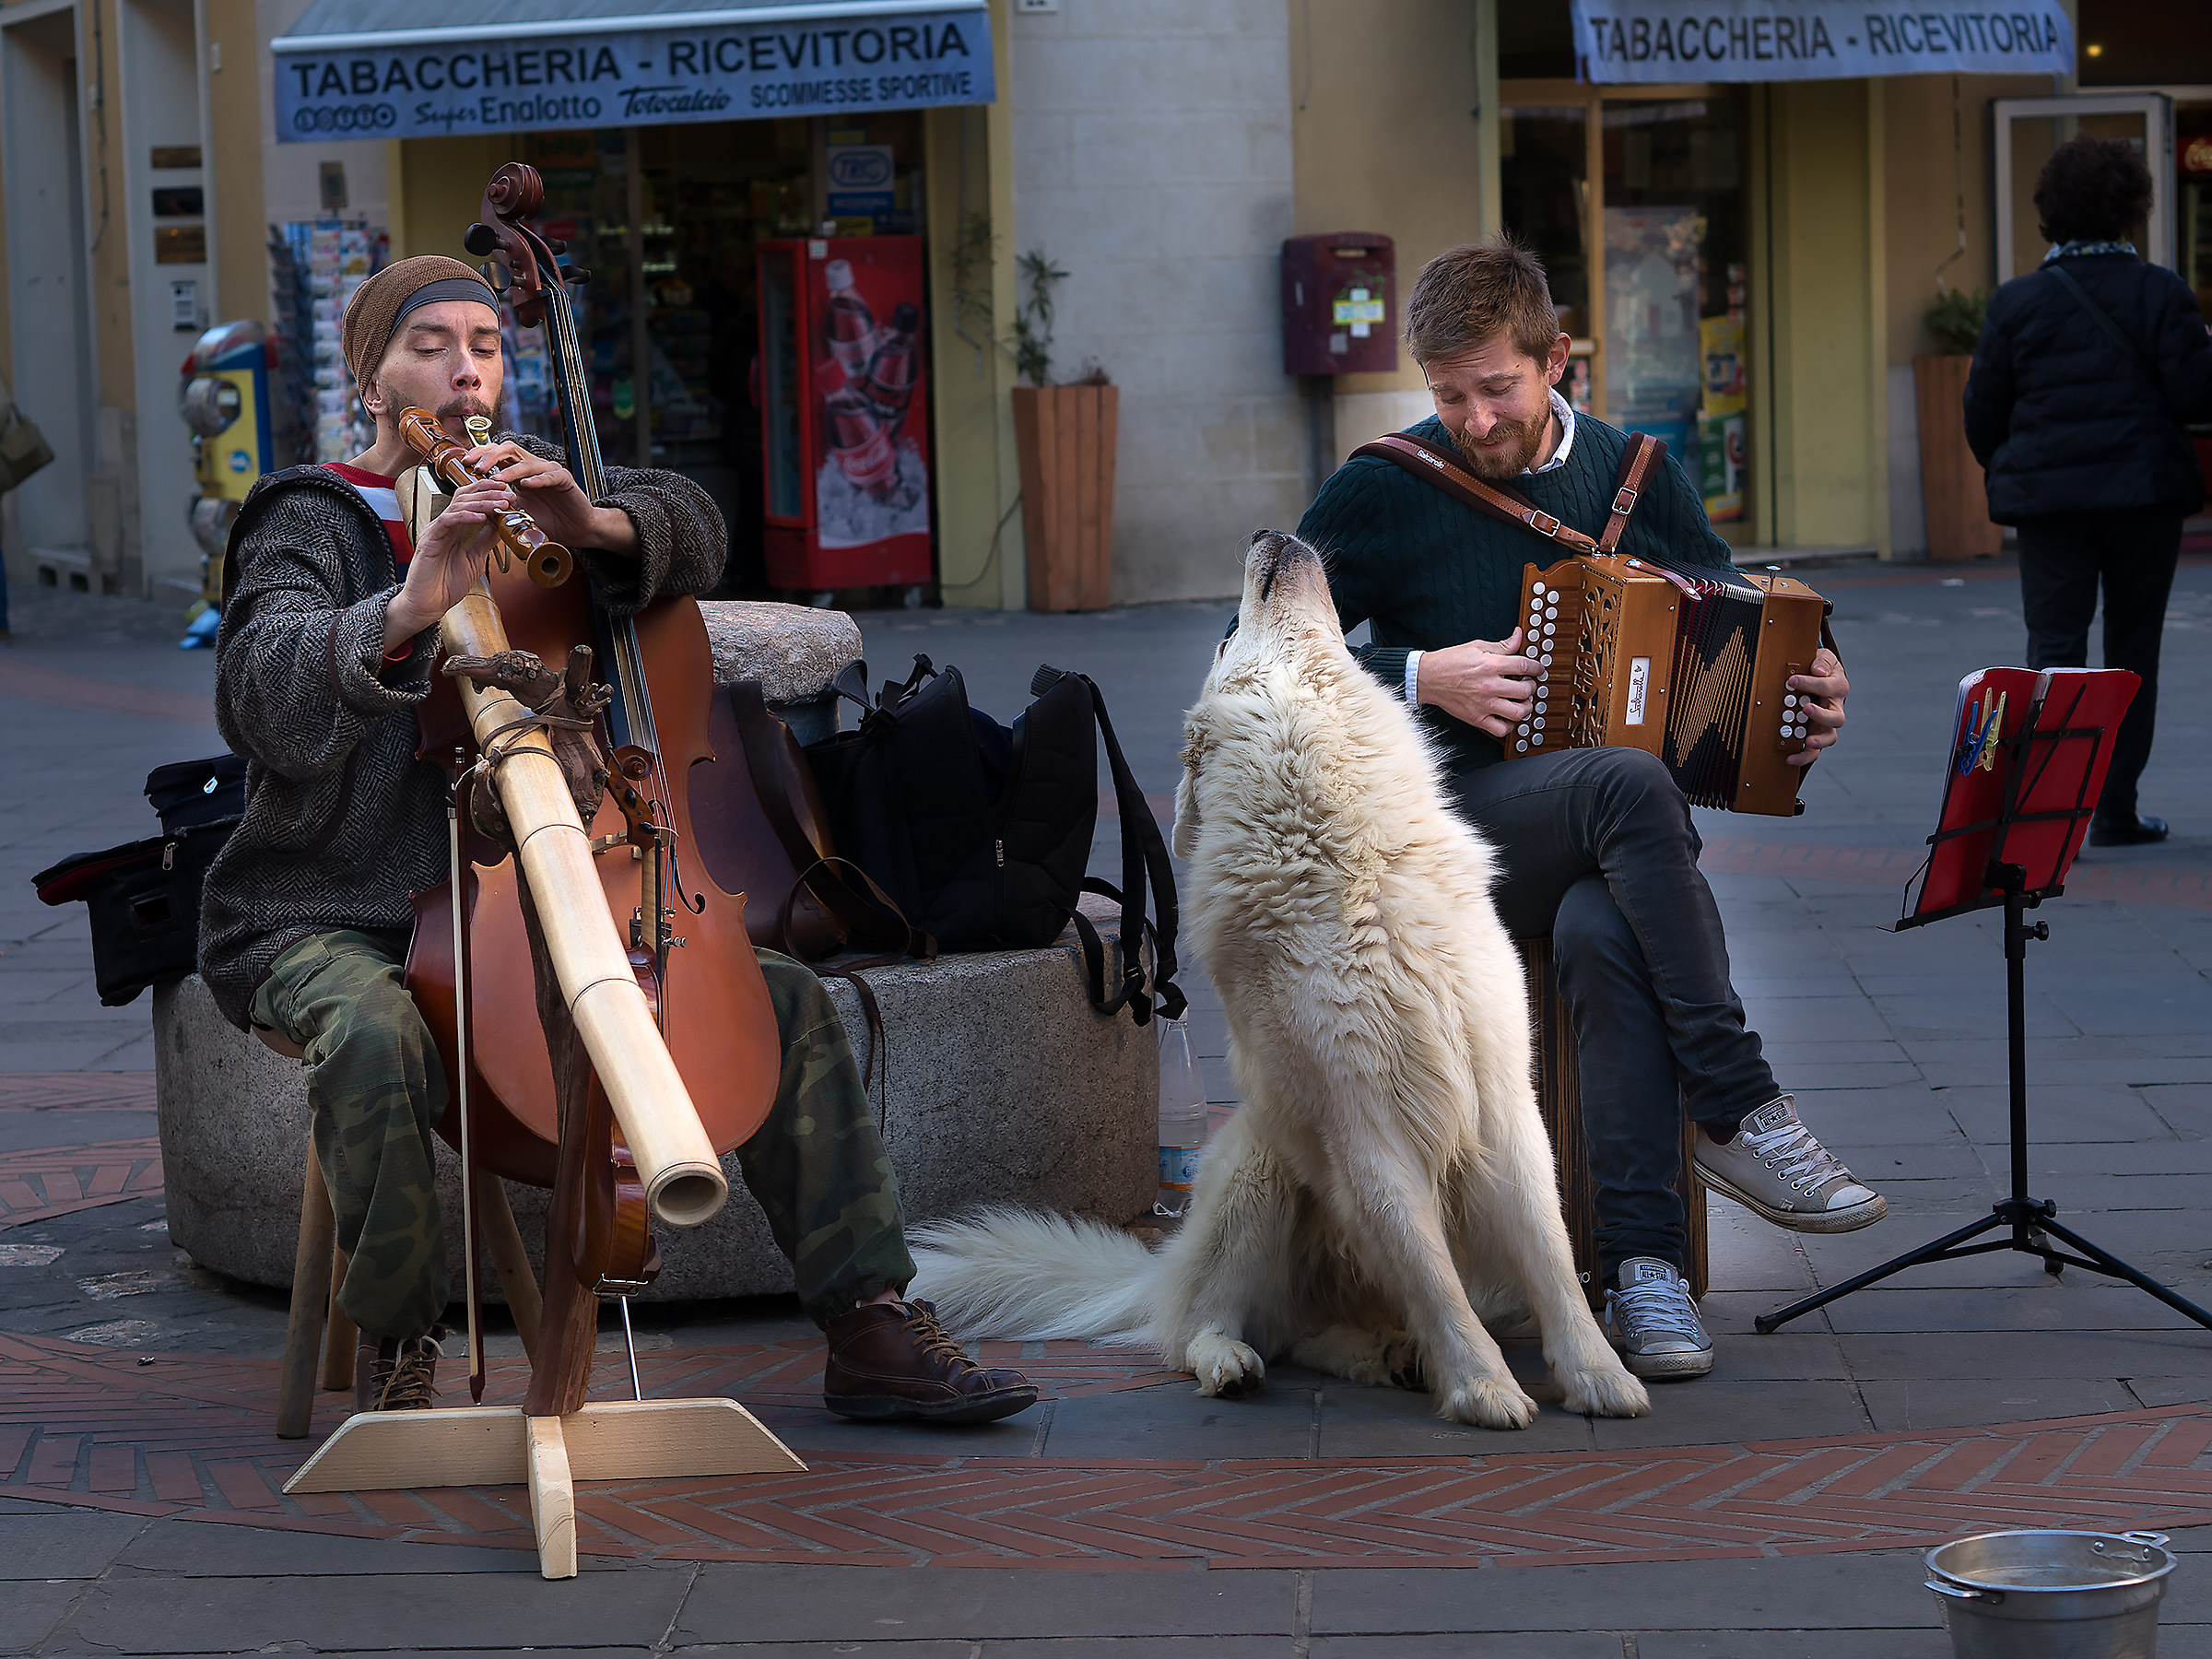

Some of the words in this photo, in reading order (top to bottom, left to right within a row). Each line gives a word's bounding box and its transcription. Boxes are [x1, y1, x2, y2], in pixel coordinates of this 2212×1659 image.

[290, 45, 622, 98] TABACCHERIA
[667, 21, 971, 76] RICEVITORIA
[1590, 16, 1836, 62] TABACCHERIA
[1865, 12, 2059, 55] RICEVITORIA
[618, 86, 732, 118] Totocalcio
[750, 77, 873, 108] SCOMMESSE
[878, 71, 972, 101] SPORTIVE
